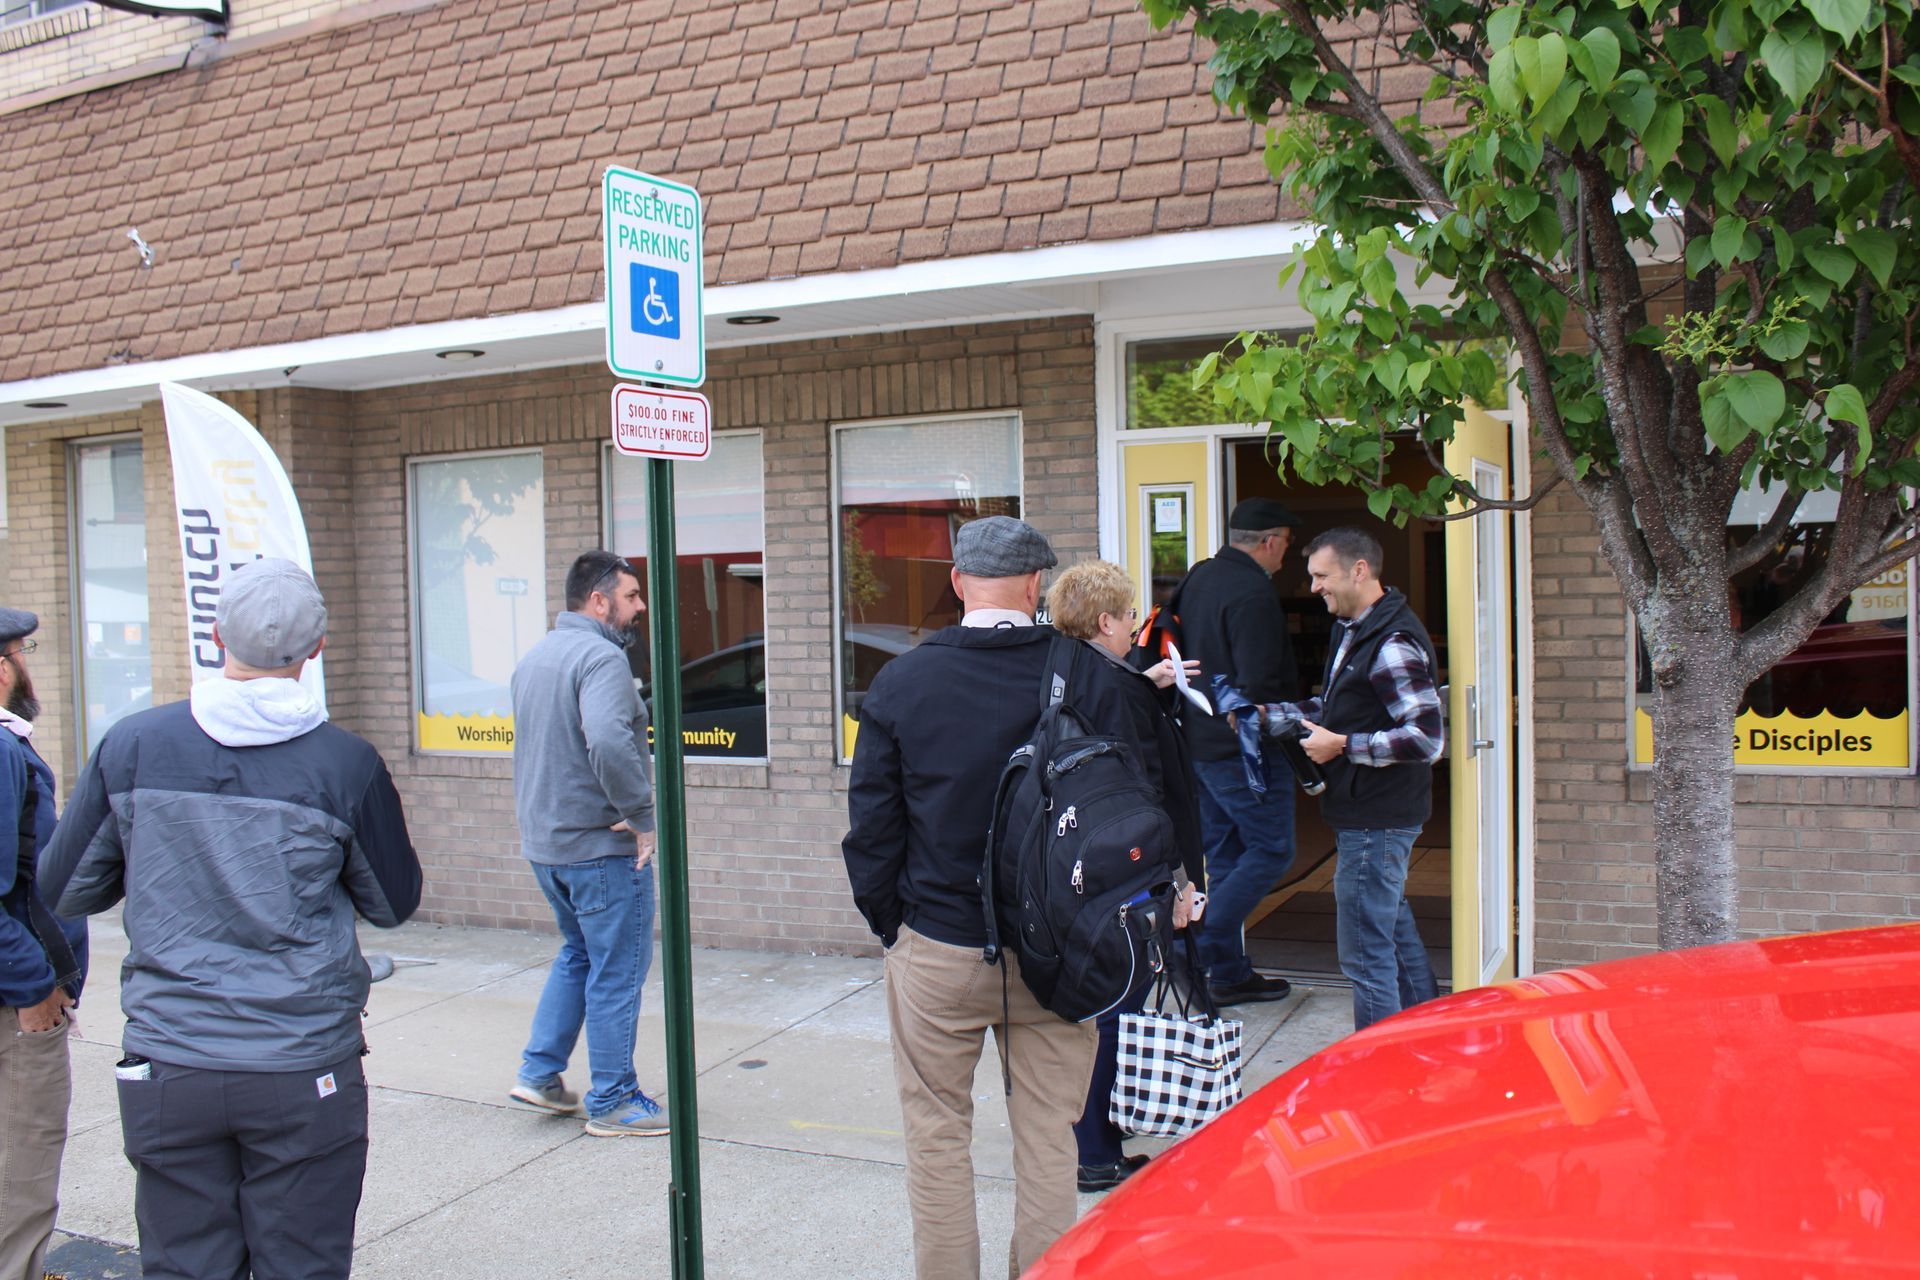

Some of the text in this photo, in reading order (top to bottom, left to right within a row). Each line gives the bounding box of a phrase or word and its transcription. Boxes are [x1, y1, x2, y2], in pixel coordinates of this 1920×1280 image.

[612, 188, 694, 230] RESERVED
[618, 224, 689, 263] PARKING
[628, 403, 695, 424] $100.00 FINE
[620, 423, 705, 444] STRICTLY ENFORCED
[456, 725, 514, 745] Worship
[1749, 729, 1872, 755] Disciples
